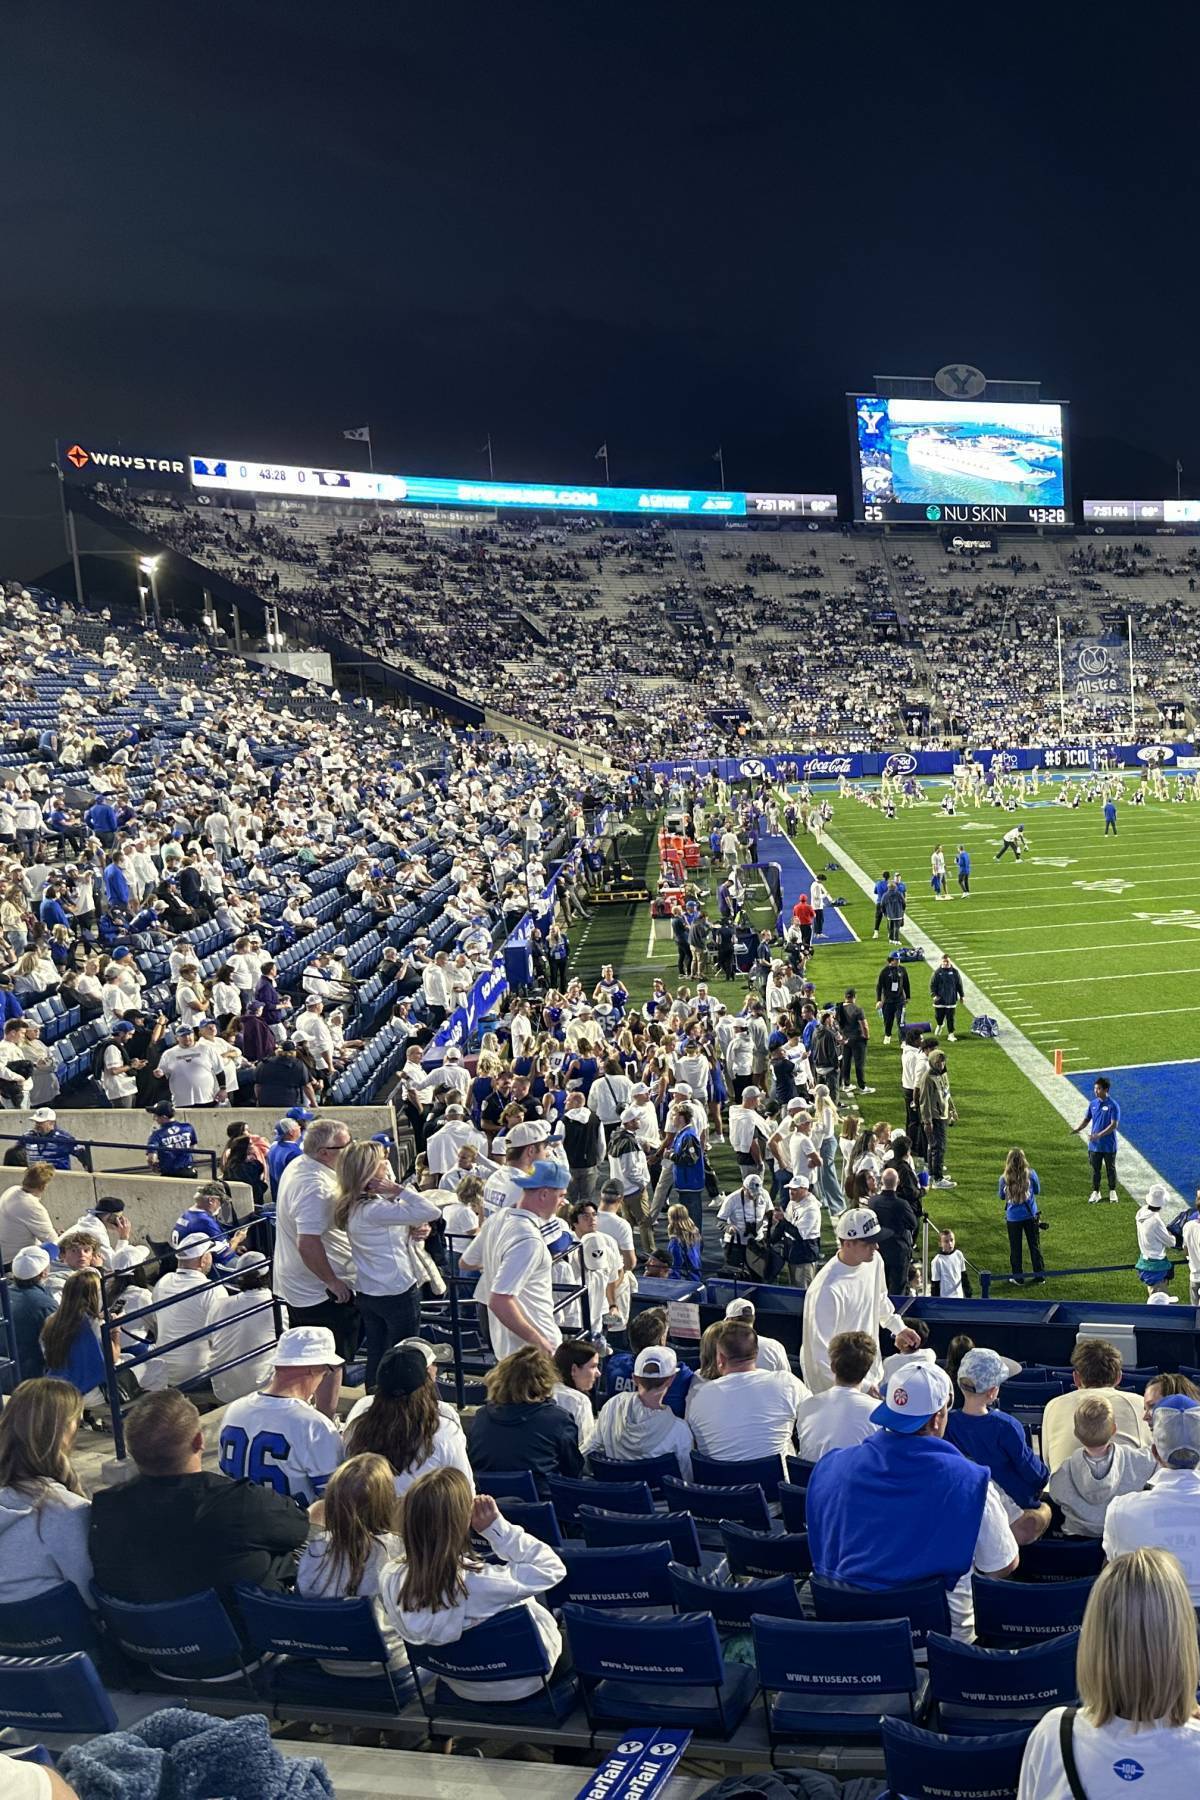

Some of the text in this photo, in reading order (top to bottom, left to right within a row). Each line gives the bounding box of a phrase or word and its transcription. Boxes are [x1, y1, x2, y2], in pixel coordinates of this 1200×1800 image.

[90, 451, 185, 474] WAYSTAR
[864, 506, 883, 521] 25
[944, 507, 1007, 522] NU SKIN
[1028, 508, 1065, 523] 43:28
[1075, 677, 1117, 695] Allstae
[569, 1591, 650, 1602] WWW.BYUSEATS.COM
[600, 1659, 685, 1675] www.byuseats.com
[786, 1671, 882, 1685] WWW.BYUSEATS.COM
[960, 1688, 1059, 1702] WWW.BYUSEATS.COM
